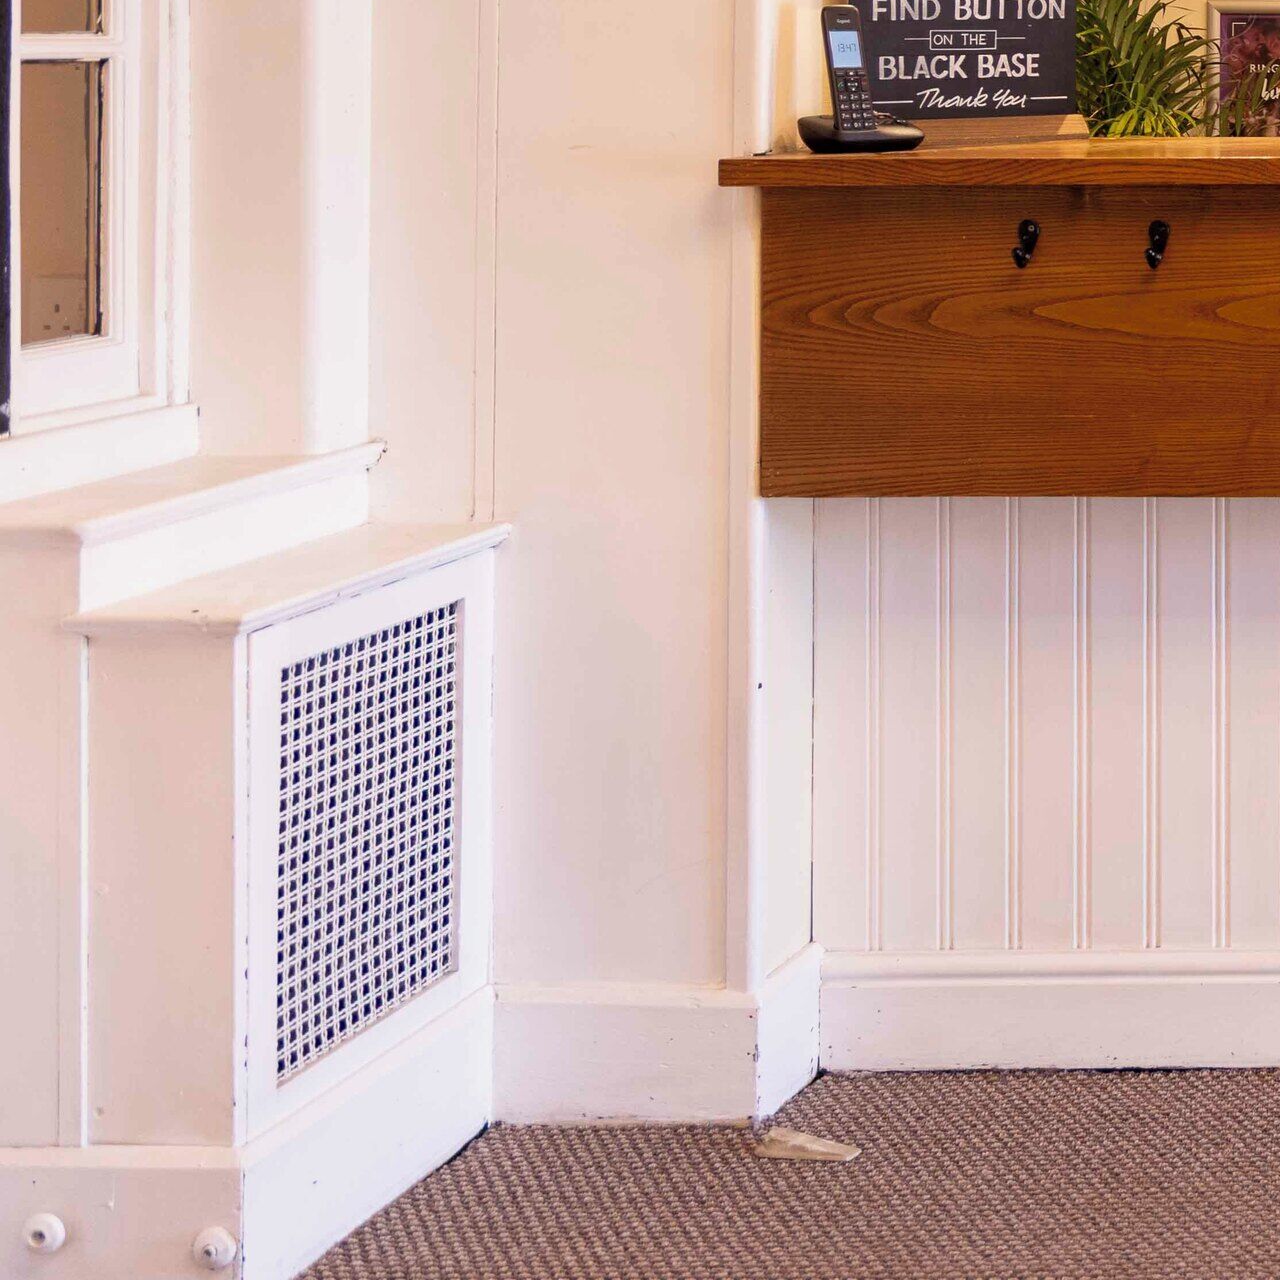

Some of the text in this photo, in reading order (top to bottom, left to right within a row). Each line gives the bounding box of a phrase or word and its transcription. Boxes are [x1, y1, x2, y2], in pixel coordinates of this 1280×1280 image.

[933, 34, 986, 46] ON THE
[878, 54, 1040, 80] BLACK BASE
[916, 87, 1026, 109] Thank You
